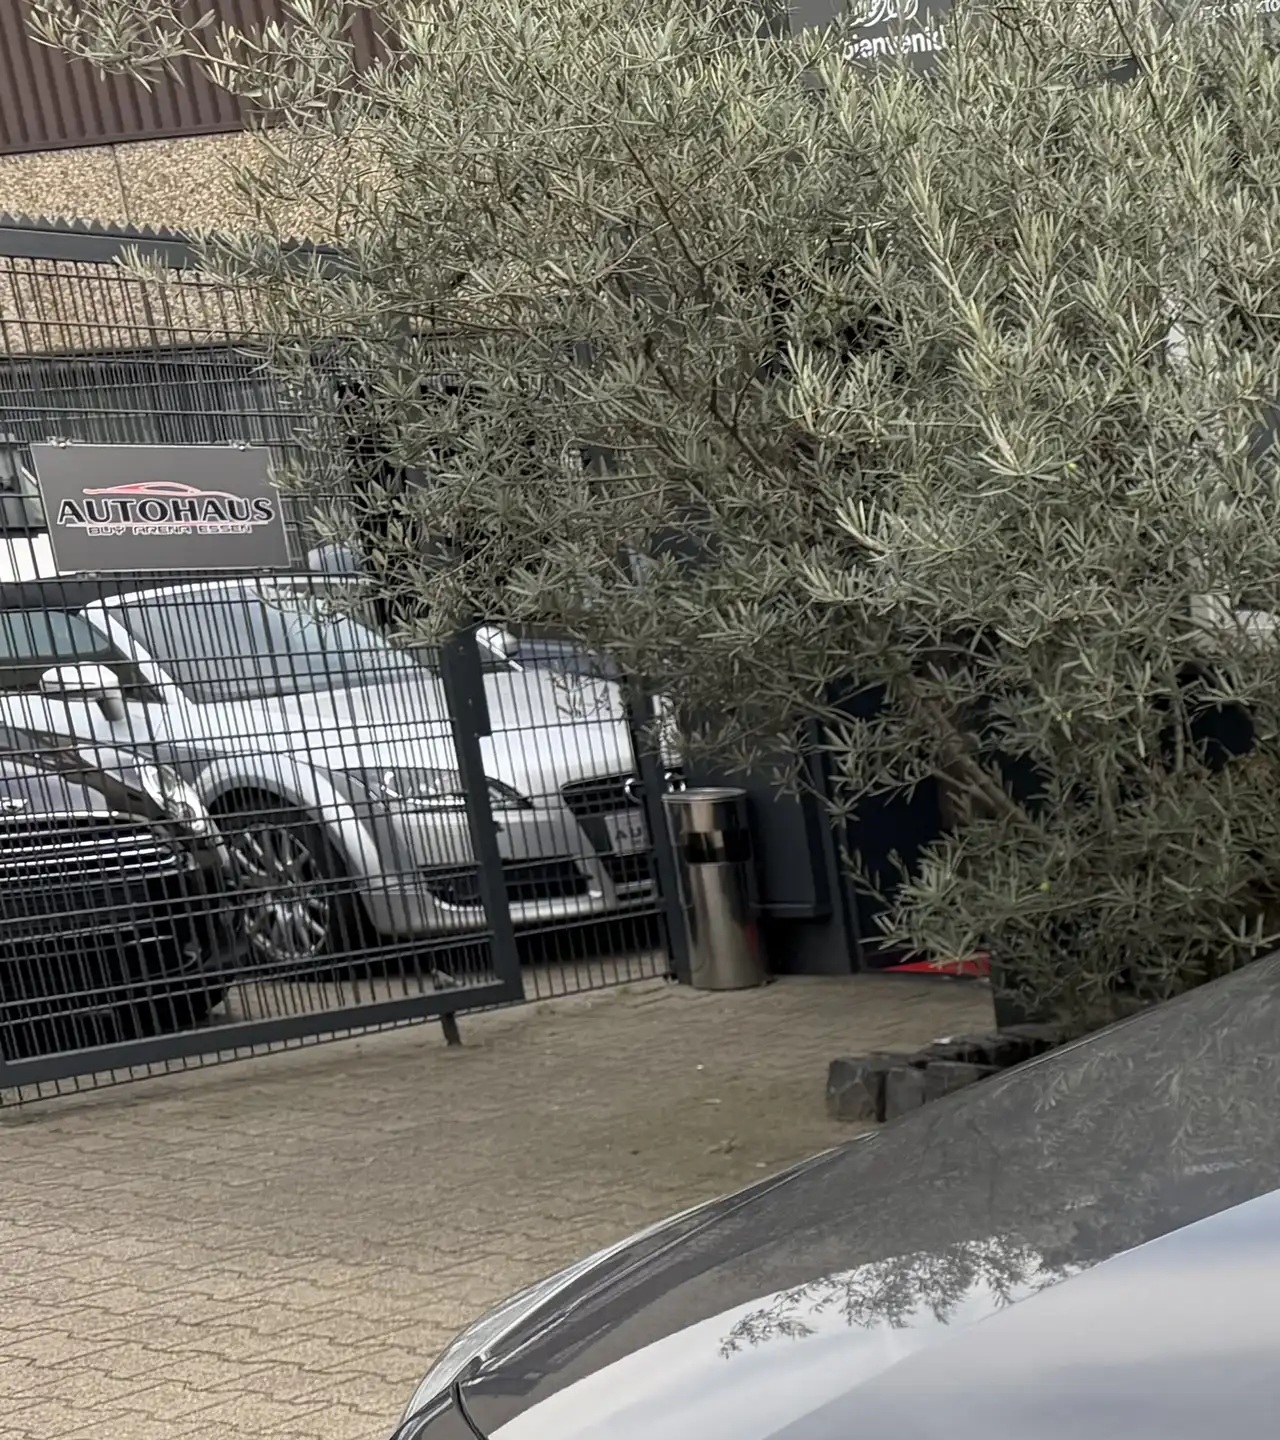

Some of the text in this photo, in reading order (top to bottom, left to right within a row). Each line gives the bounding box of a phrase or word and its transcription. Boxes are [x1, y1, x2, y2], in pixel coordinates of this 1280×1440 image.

[57, 498, 274, 524] AUTOHAUS
[87, 524, 253, 536] BUY ARENA ESSEN
